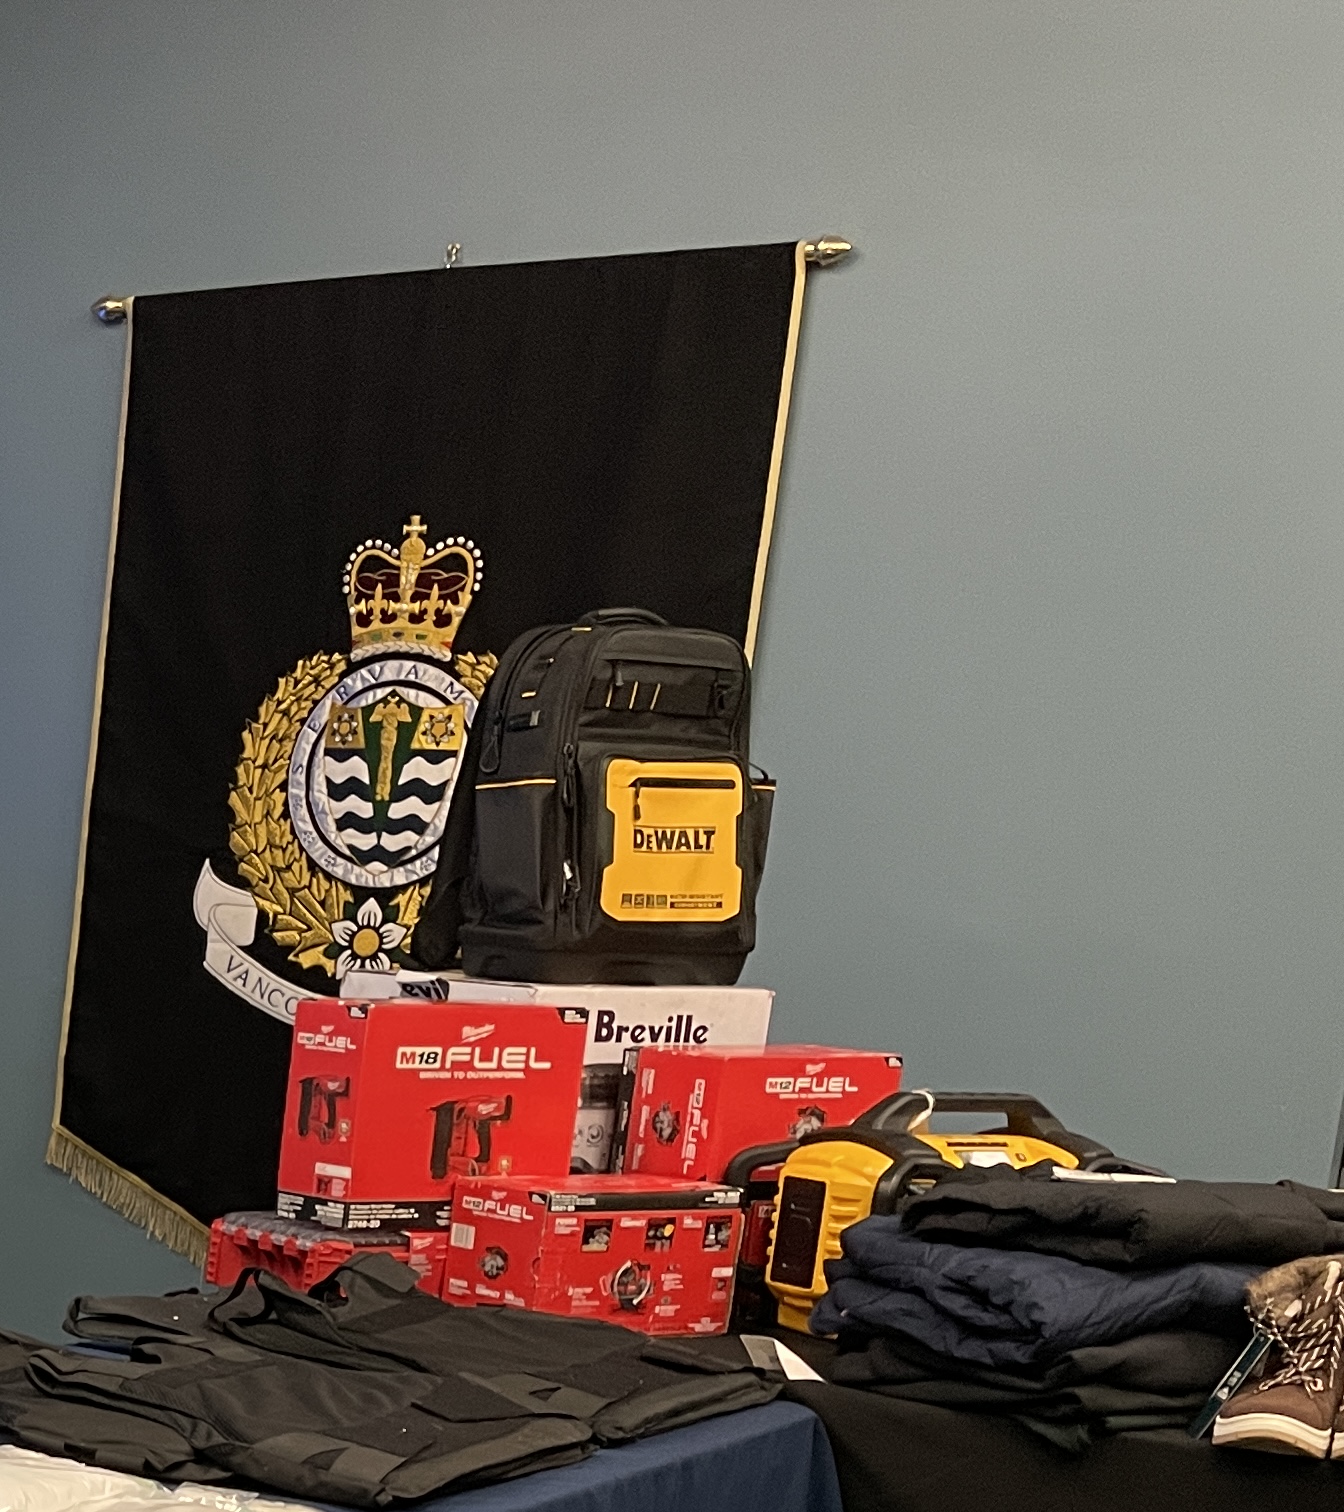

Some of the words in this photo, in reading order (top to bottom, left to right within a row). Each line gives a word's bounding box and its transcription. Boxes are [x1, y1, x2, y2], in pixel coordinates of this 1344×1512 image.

[292, 664, 465, 776] SERVAM
[225, 954, 298, 1017] VANCO
[594, 1009, 710, 1045] Breville
[314, 1034, 357, 1050] FUEL
[400, 1050, 441, 1067] M18
[445, 1046, 552, 1070] FUEL
[793, 1077, 859, 1093] FUEL
[483, 1200, 534, 1221] FUEL
